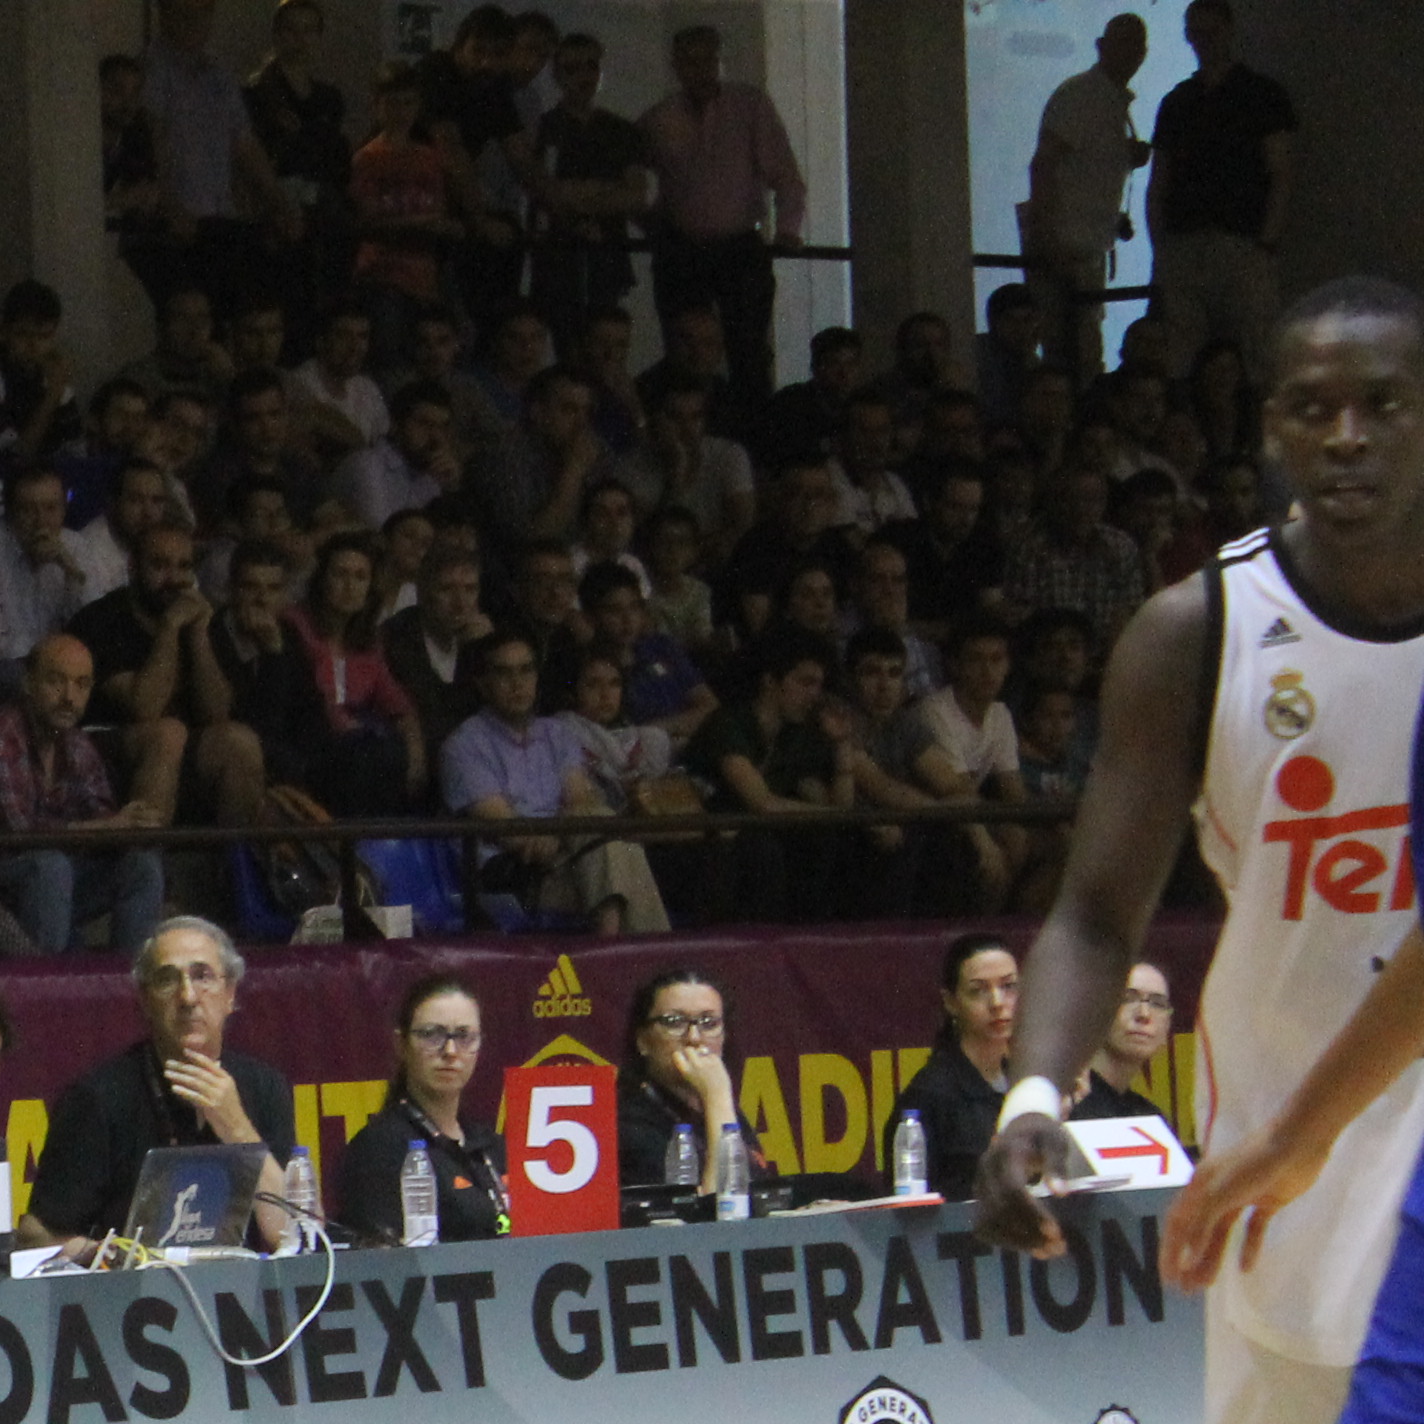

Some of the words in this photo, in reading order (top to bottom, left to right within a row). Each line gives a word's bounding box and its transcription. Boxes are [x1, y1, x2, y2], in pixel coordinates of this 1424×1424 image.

[533, 994, 592, 1017] adidas
[523, 1085, 599, 1194] 5
[214, 1270, 496, 1411] NEXT
[532, 1214, 1165, 1382] GENERATION
